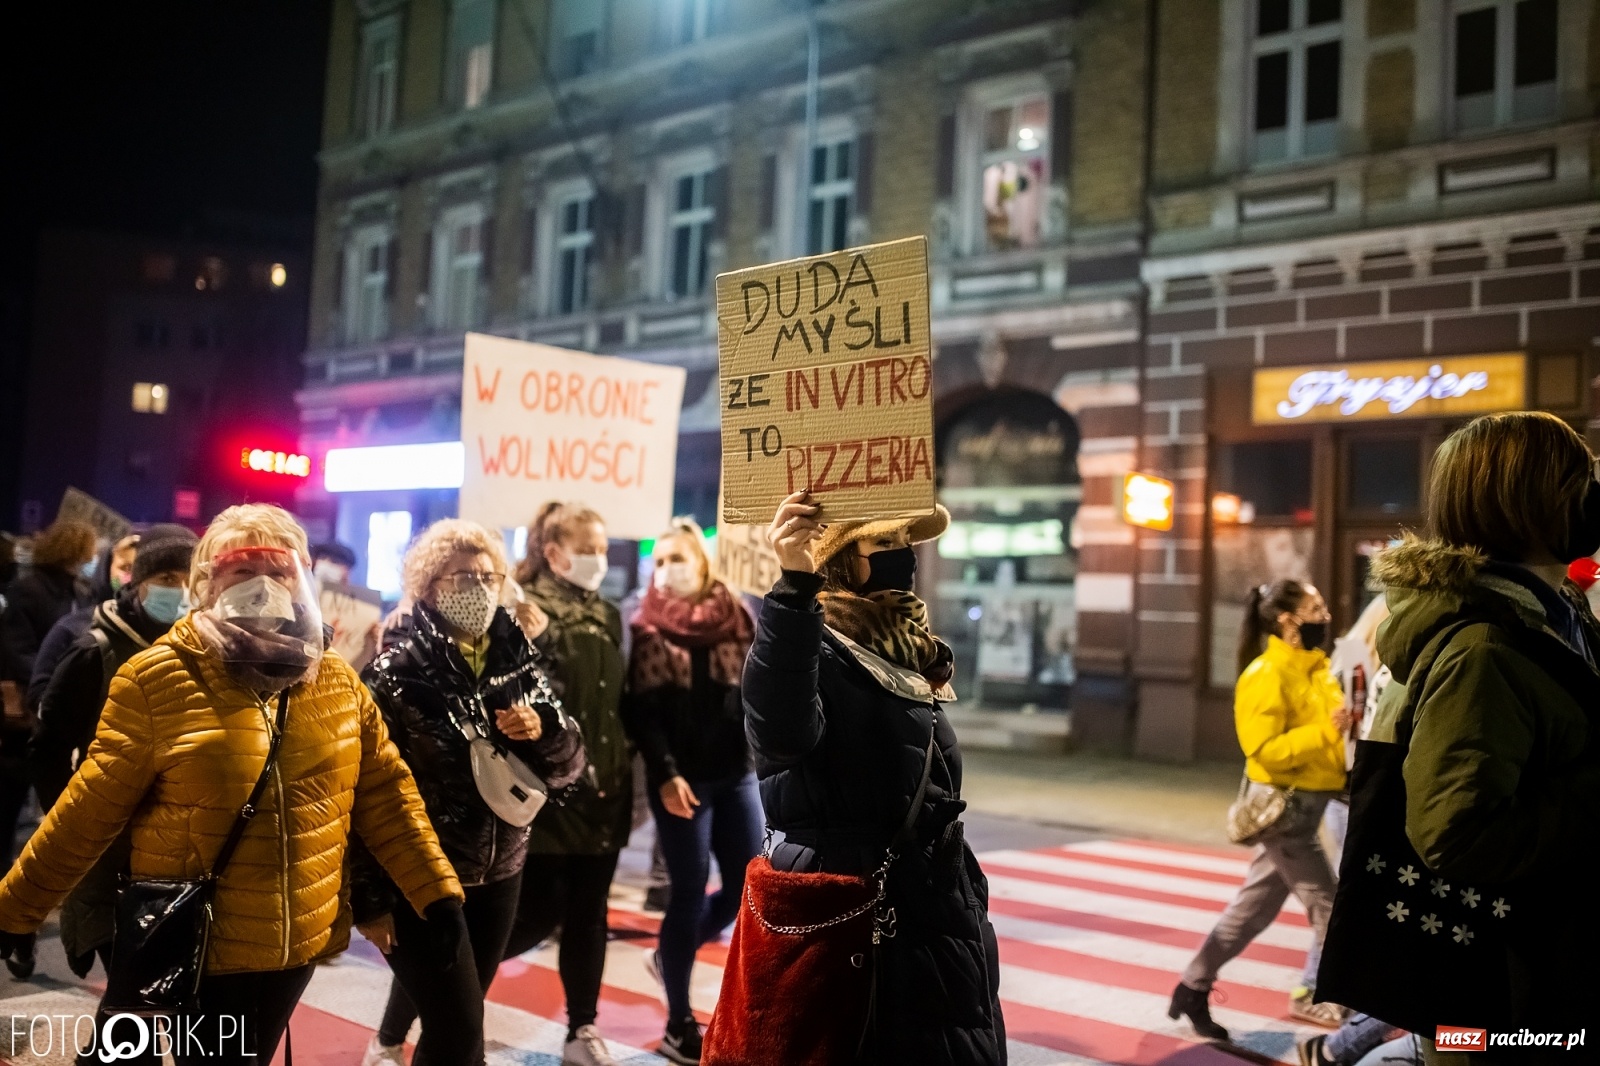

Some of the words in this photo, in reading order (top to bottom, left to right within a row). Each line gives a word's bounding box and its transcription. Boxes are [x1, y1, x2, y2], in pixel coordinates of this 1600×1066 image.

[741, 254, 879, 335] DUDA
[771, 299, 911, 361] MYŚLI
[474, 362, 502, 403] W
[520, 370, 660, 425] OBRONIE
[785, 367, 819, 412] IN
[830, 355, 931, 411] VITRO
[1276, 364, 1488, 418] Fryzjer
[478, 429, 646, 488] WOLNOŚCI
[740, 425, 782, 462] TO
[786, 436, 932, 494] PIZZERIA
